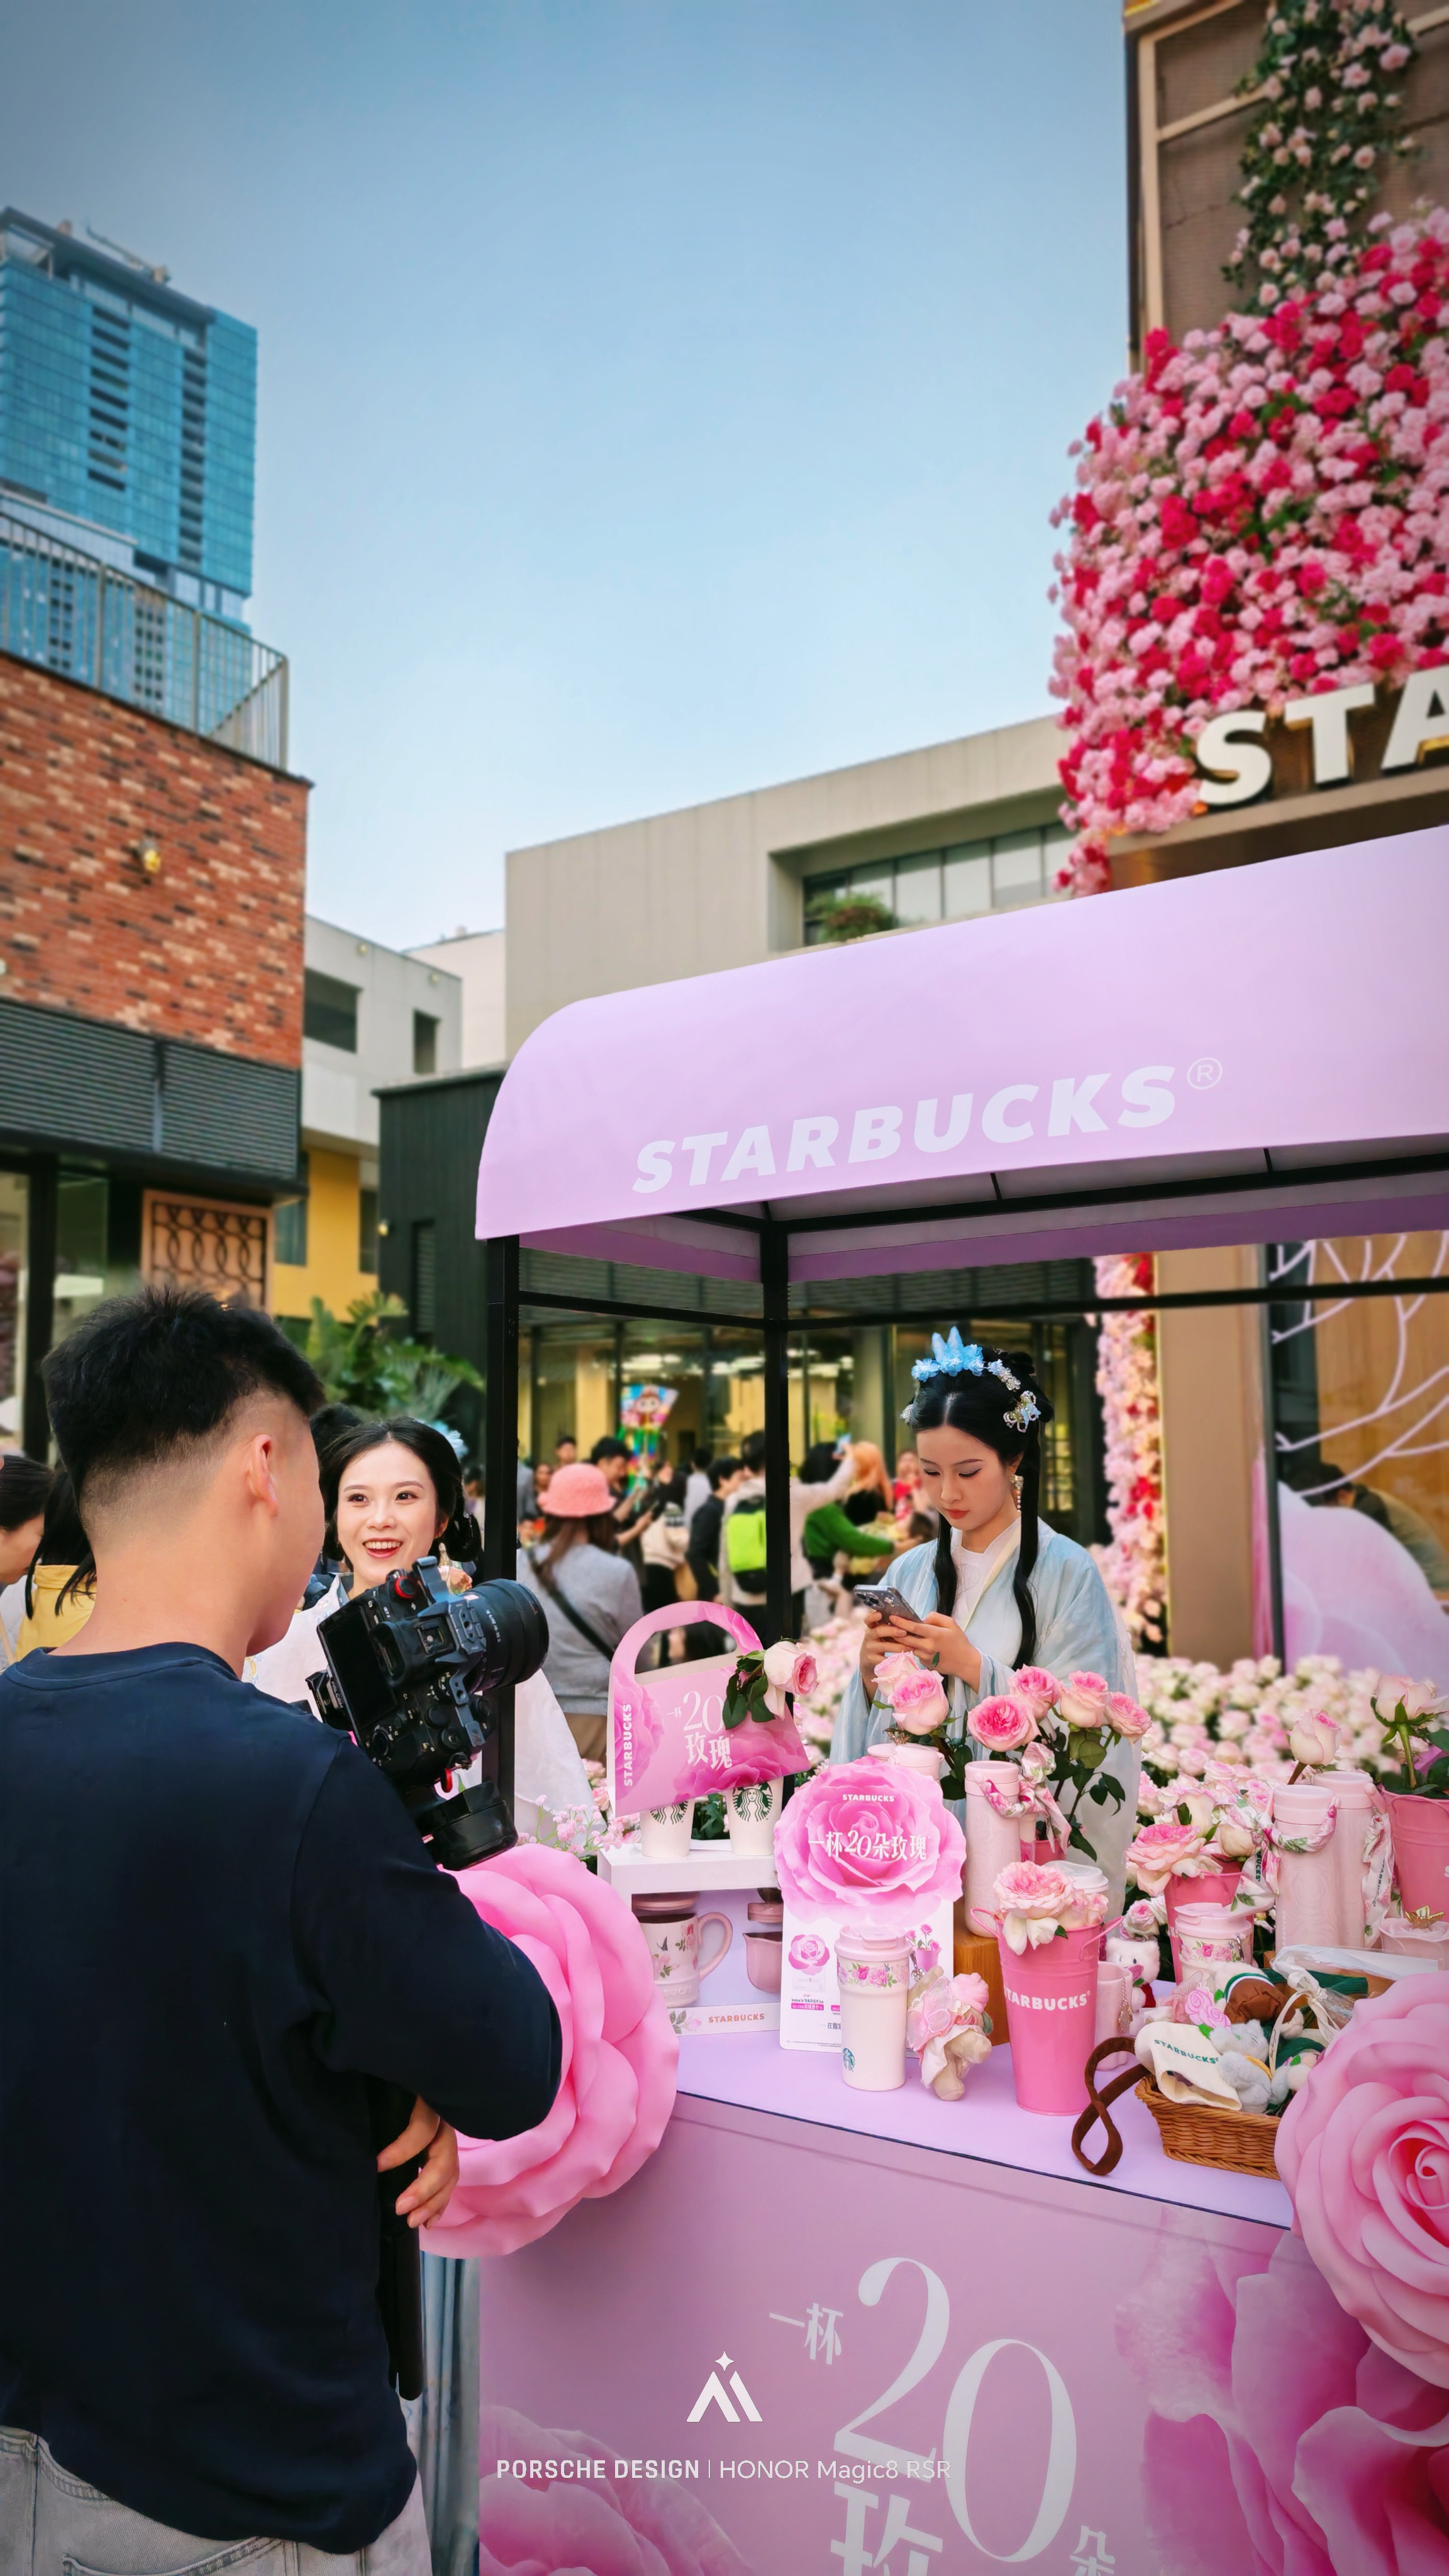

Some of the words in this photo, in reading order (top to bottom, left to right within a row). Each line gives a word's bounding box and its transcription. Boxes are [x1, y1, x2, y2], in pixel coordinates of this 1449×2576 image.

[683, 1691, 724, 1733] 20
[623, 1704, 633, 1787] STARBUCKS
[685, 1732, 733, 1771] 玫瑰
[842, 1794, 895, 1802] STARBUCKS
[808, 1829, 927, 1862] 一杯20朵玫瑰
[1004, 1984, 1088, 2011] TARBUCKS
[708, 2013, 765, 2023] STARBUCKS
[1154, 2040, 1217, 2064] STARBUCKS
[769, 2302, 844, 2365] 一杯
[833, 2257, 1077, 2562] 20
